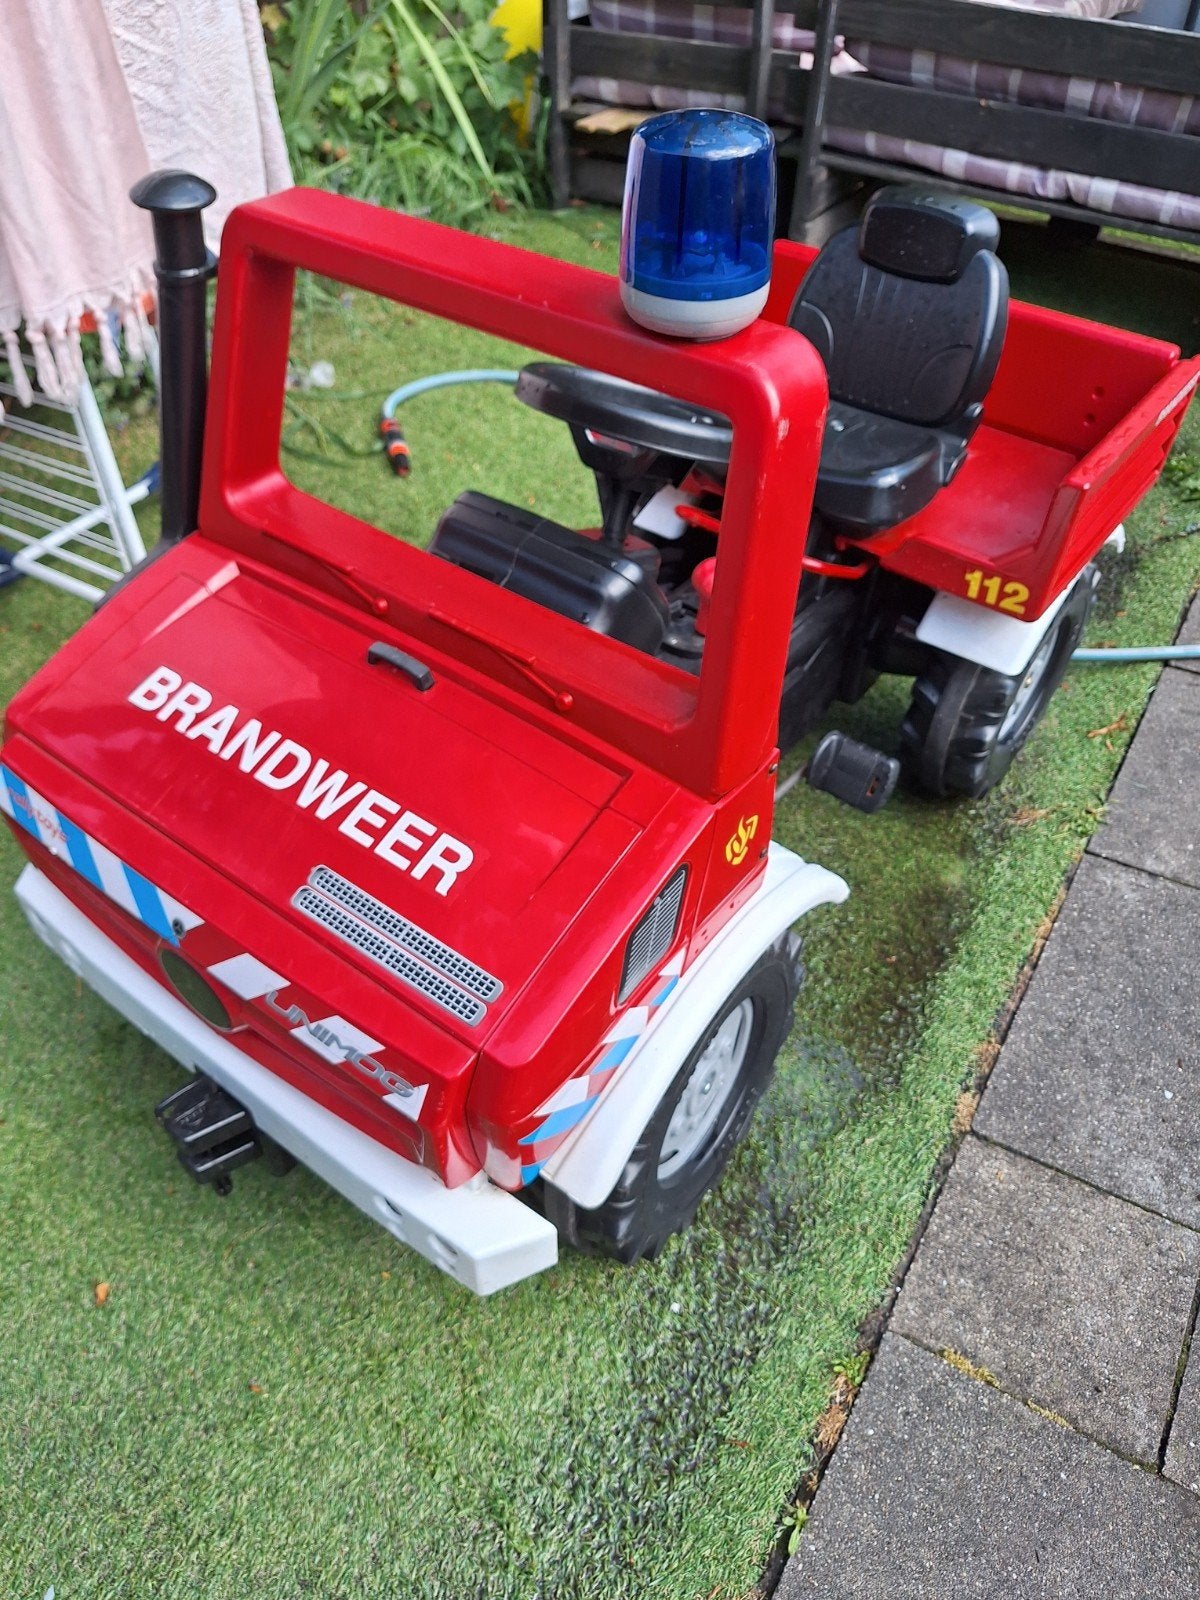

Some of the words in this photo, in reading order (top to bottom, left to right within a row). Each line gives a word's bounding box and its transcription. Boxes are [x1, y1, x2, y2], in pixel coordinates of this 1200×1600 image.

[964, 569, 1030, 615] 112
[127, 664, 475, 898] BRANDWEER
[265, 990, 417, 1098] UNIMOG
